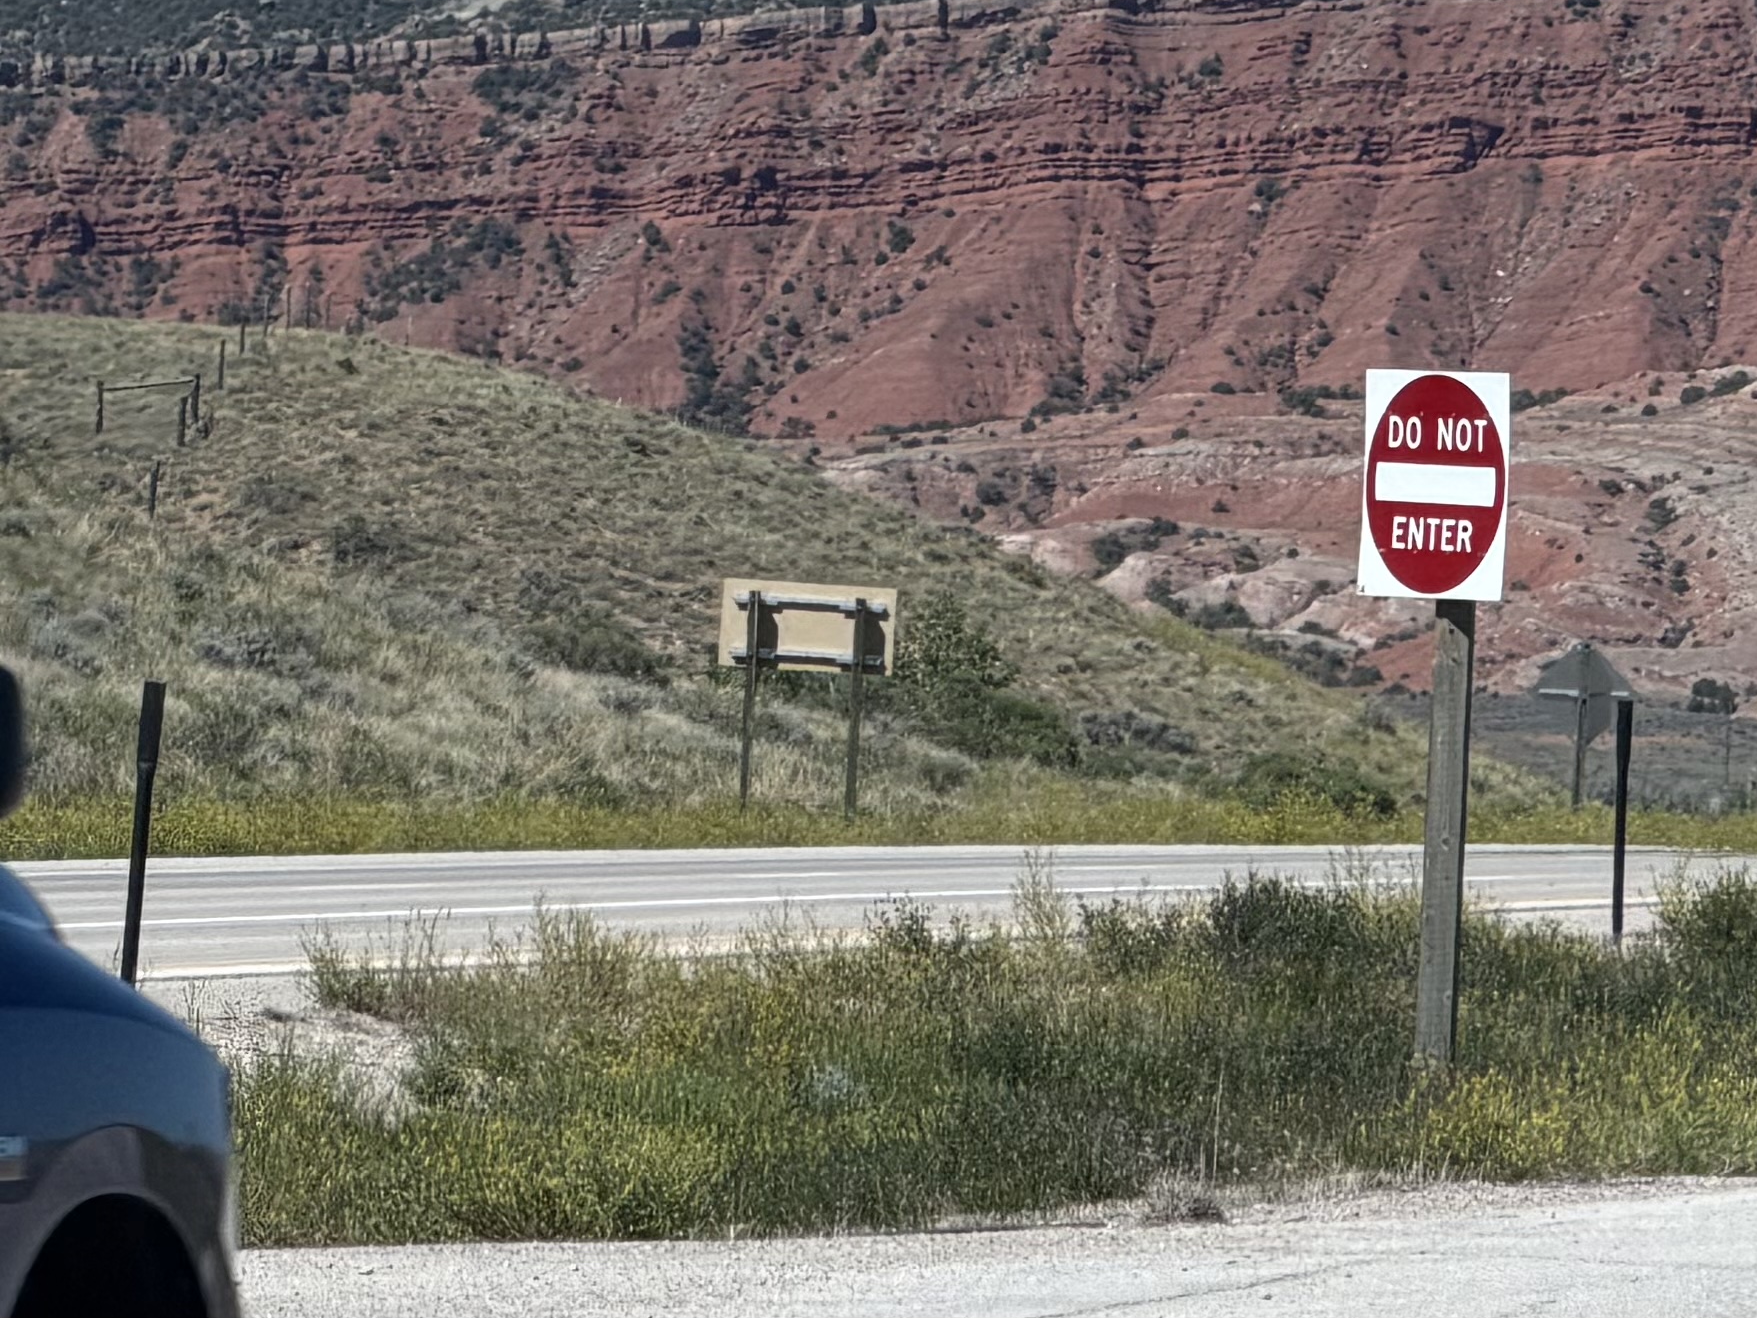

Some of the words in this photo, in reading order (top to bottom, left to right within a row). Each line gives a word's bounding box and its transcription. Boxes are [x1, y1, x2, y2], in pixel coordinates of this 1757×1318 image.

[1388, 415, 1422, 450] DO
[1437, 418, 1488, 453] NOT
[1391, 516, 1473, 553] ENTER
